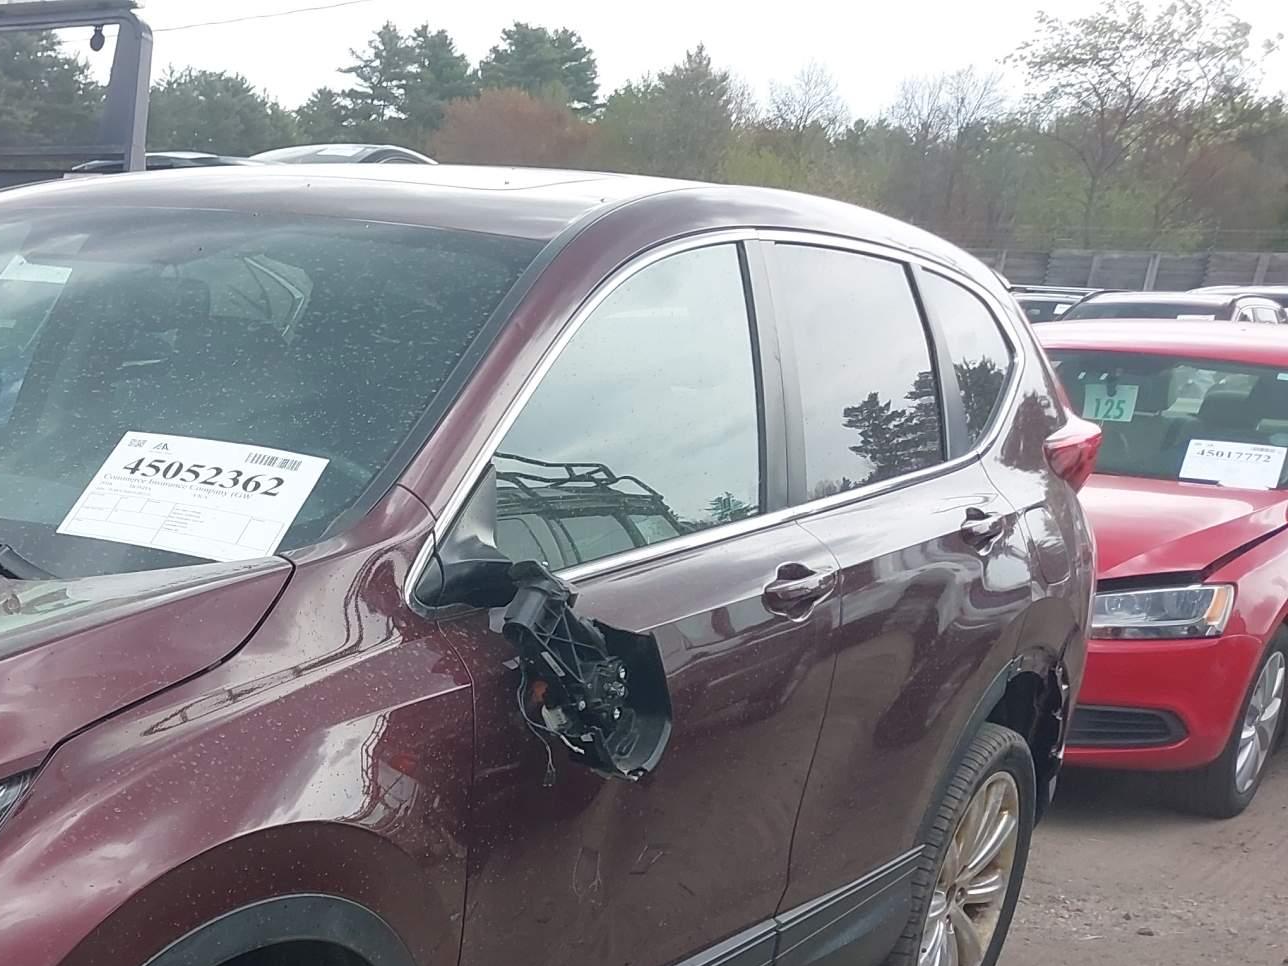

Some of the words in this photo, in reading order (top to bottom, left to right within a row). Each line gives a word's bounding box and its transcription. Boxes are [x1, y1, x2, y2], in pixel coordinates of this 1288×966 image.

[1094, 399, 1127, 419] 125
[1196, 448, 1272, 463] 45017772
[122, 456, 285, 497] 45052362
